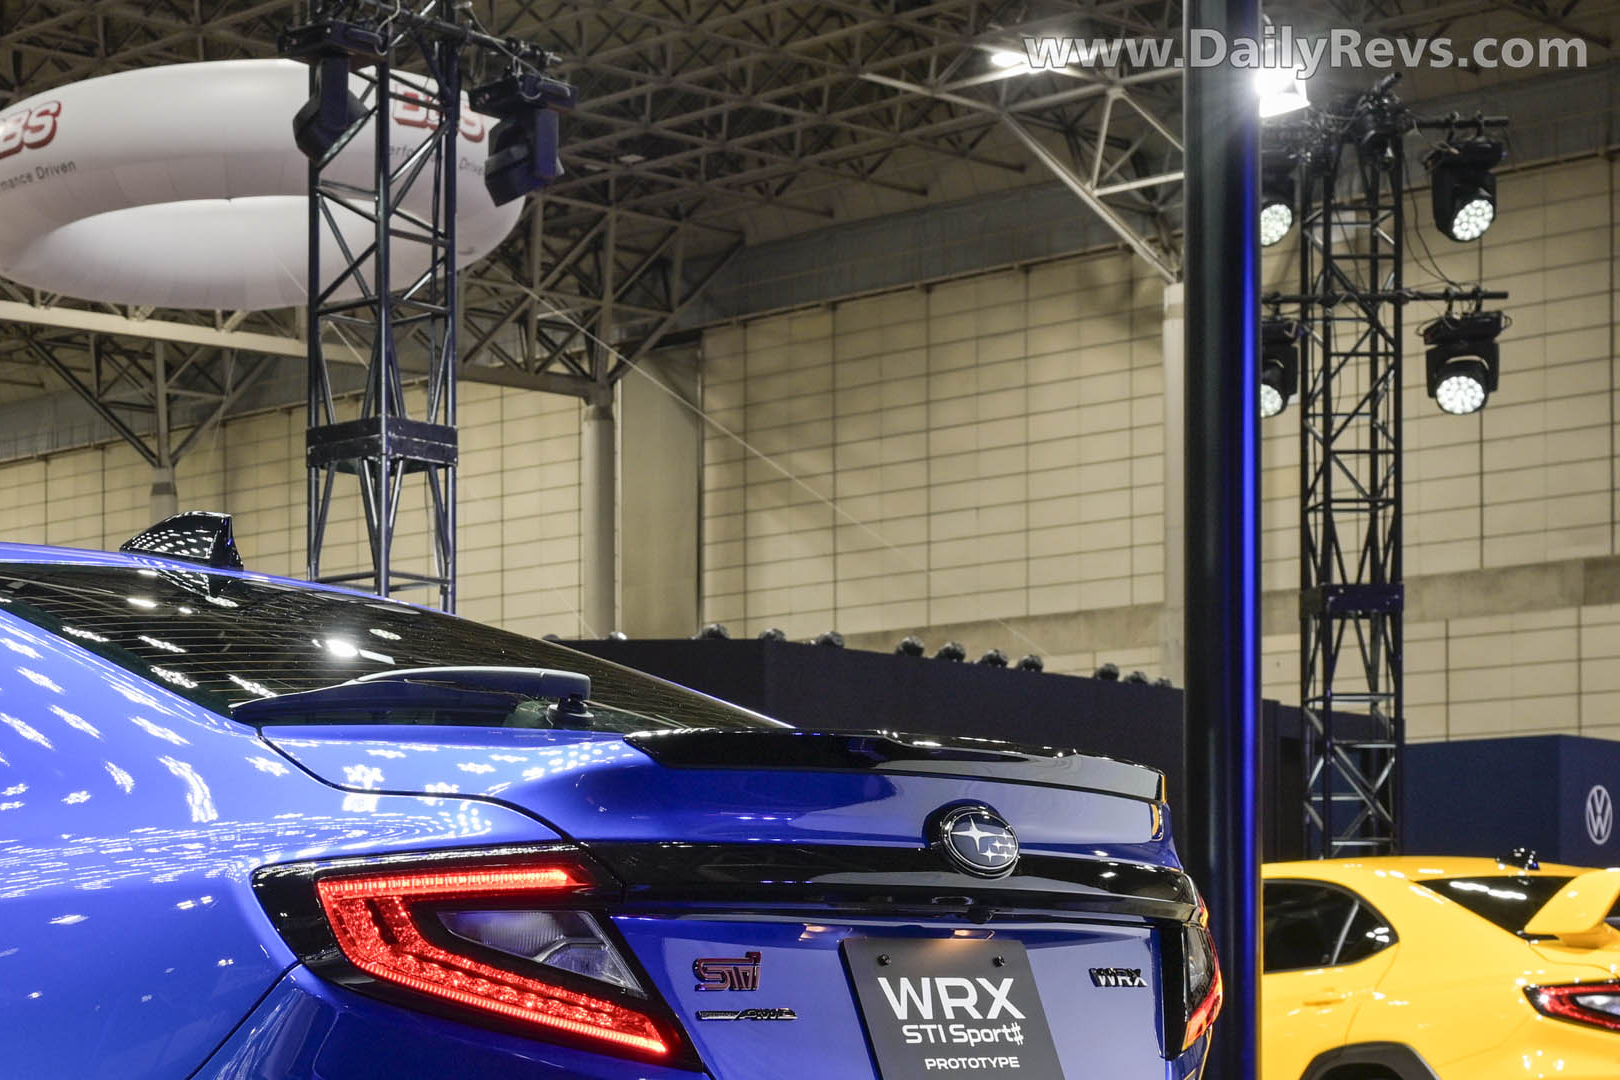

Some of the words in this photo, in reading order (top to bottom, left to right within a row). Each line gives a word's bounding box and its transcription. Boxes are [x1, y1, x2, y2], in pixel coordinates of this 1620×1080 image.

[35, 160, 77, 180] Driven
[1089, 967, 1148, 987] WRX
[877, 977, 1027, 1020] WRX
[902, 1024, 947, 1044] STI
[924, 1056, 1021, 1070] PROTOTYPE
